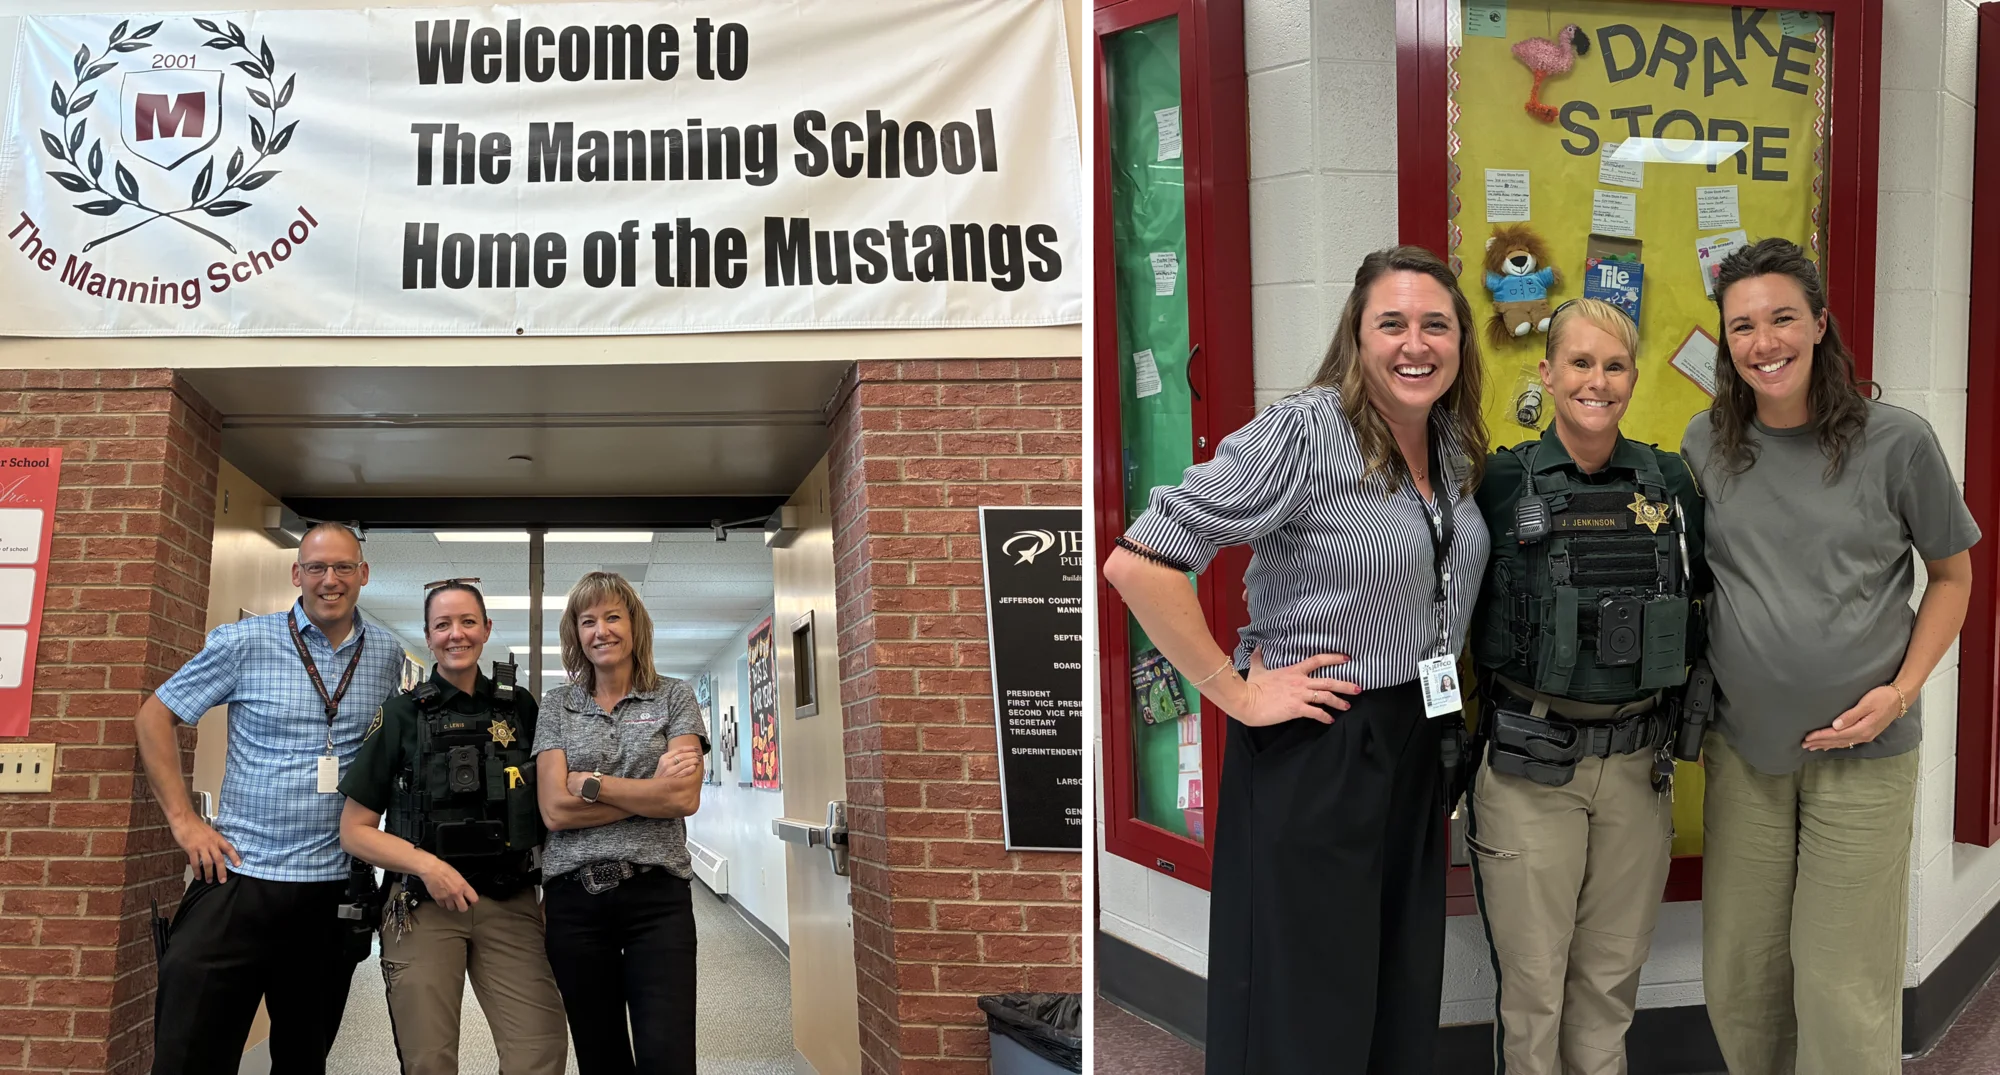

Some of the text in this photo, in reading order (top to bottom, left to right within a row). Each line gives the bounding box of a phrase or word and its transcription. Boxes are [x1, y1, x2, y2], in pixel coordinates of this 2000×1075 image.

[415, 17, 749, 85] Welcome to
[1596, 7, 1817, 97] DRAKE
[151, 54, 197, 69] 2001
[135, 91, 206, 142] M
[410, 108, 998, 187] The Manning School
[1558, 100, 1790, 182] STORE
[7, 205, 319, 310] The Manning School
[402, 216, 1063, 292] Home of the Mustangs
[9, 457, 50, 468] School
[1572, 518, 1615, 527] JENKINSON
[1054, 662, 1081, 670] BOARD
[1006, 690, 1051, 698] PRESIDENT
[1008, 709, 1042, 717] SECOND
[1010, 728, 1057, 736] TREASURER
[1011, 748, 1083, 756] SUPERINTENDENT
[1065, 808, 1083, 816] GEN
